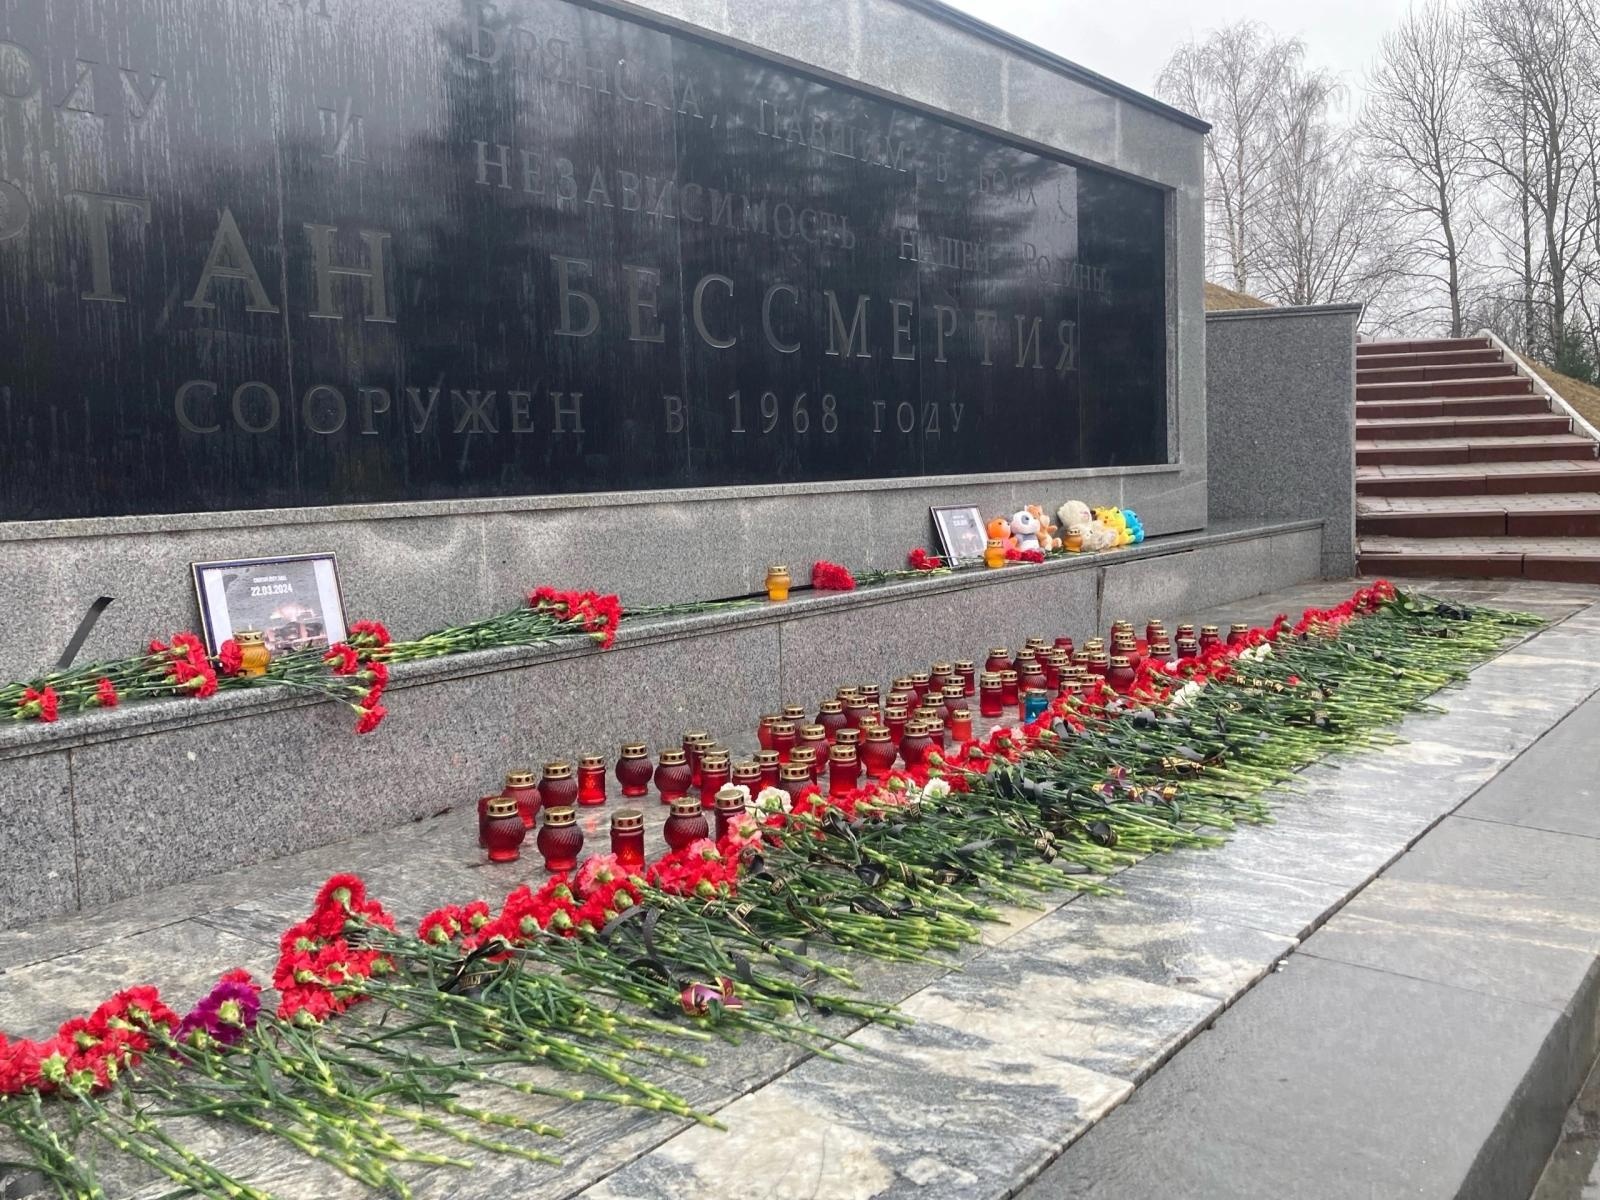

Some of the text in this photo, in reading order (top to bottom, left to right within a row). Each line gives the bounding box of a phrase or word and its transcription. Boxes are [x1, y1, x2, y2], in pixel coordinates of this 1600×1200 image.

[473, 140, 856, 250] НЕЗАВИСИМОСТЬ
[550, 254, 1076, 372] БЕССМЕРТИЯ
[174, 379, 964, 438] СООРУЖЕН В 1968 ГОДУ
[251, 582, 293, 596] 22.03.2024
